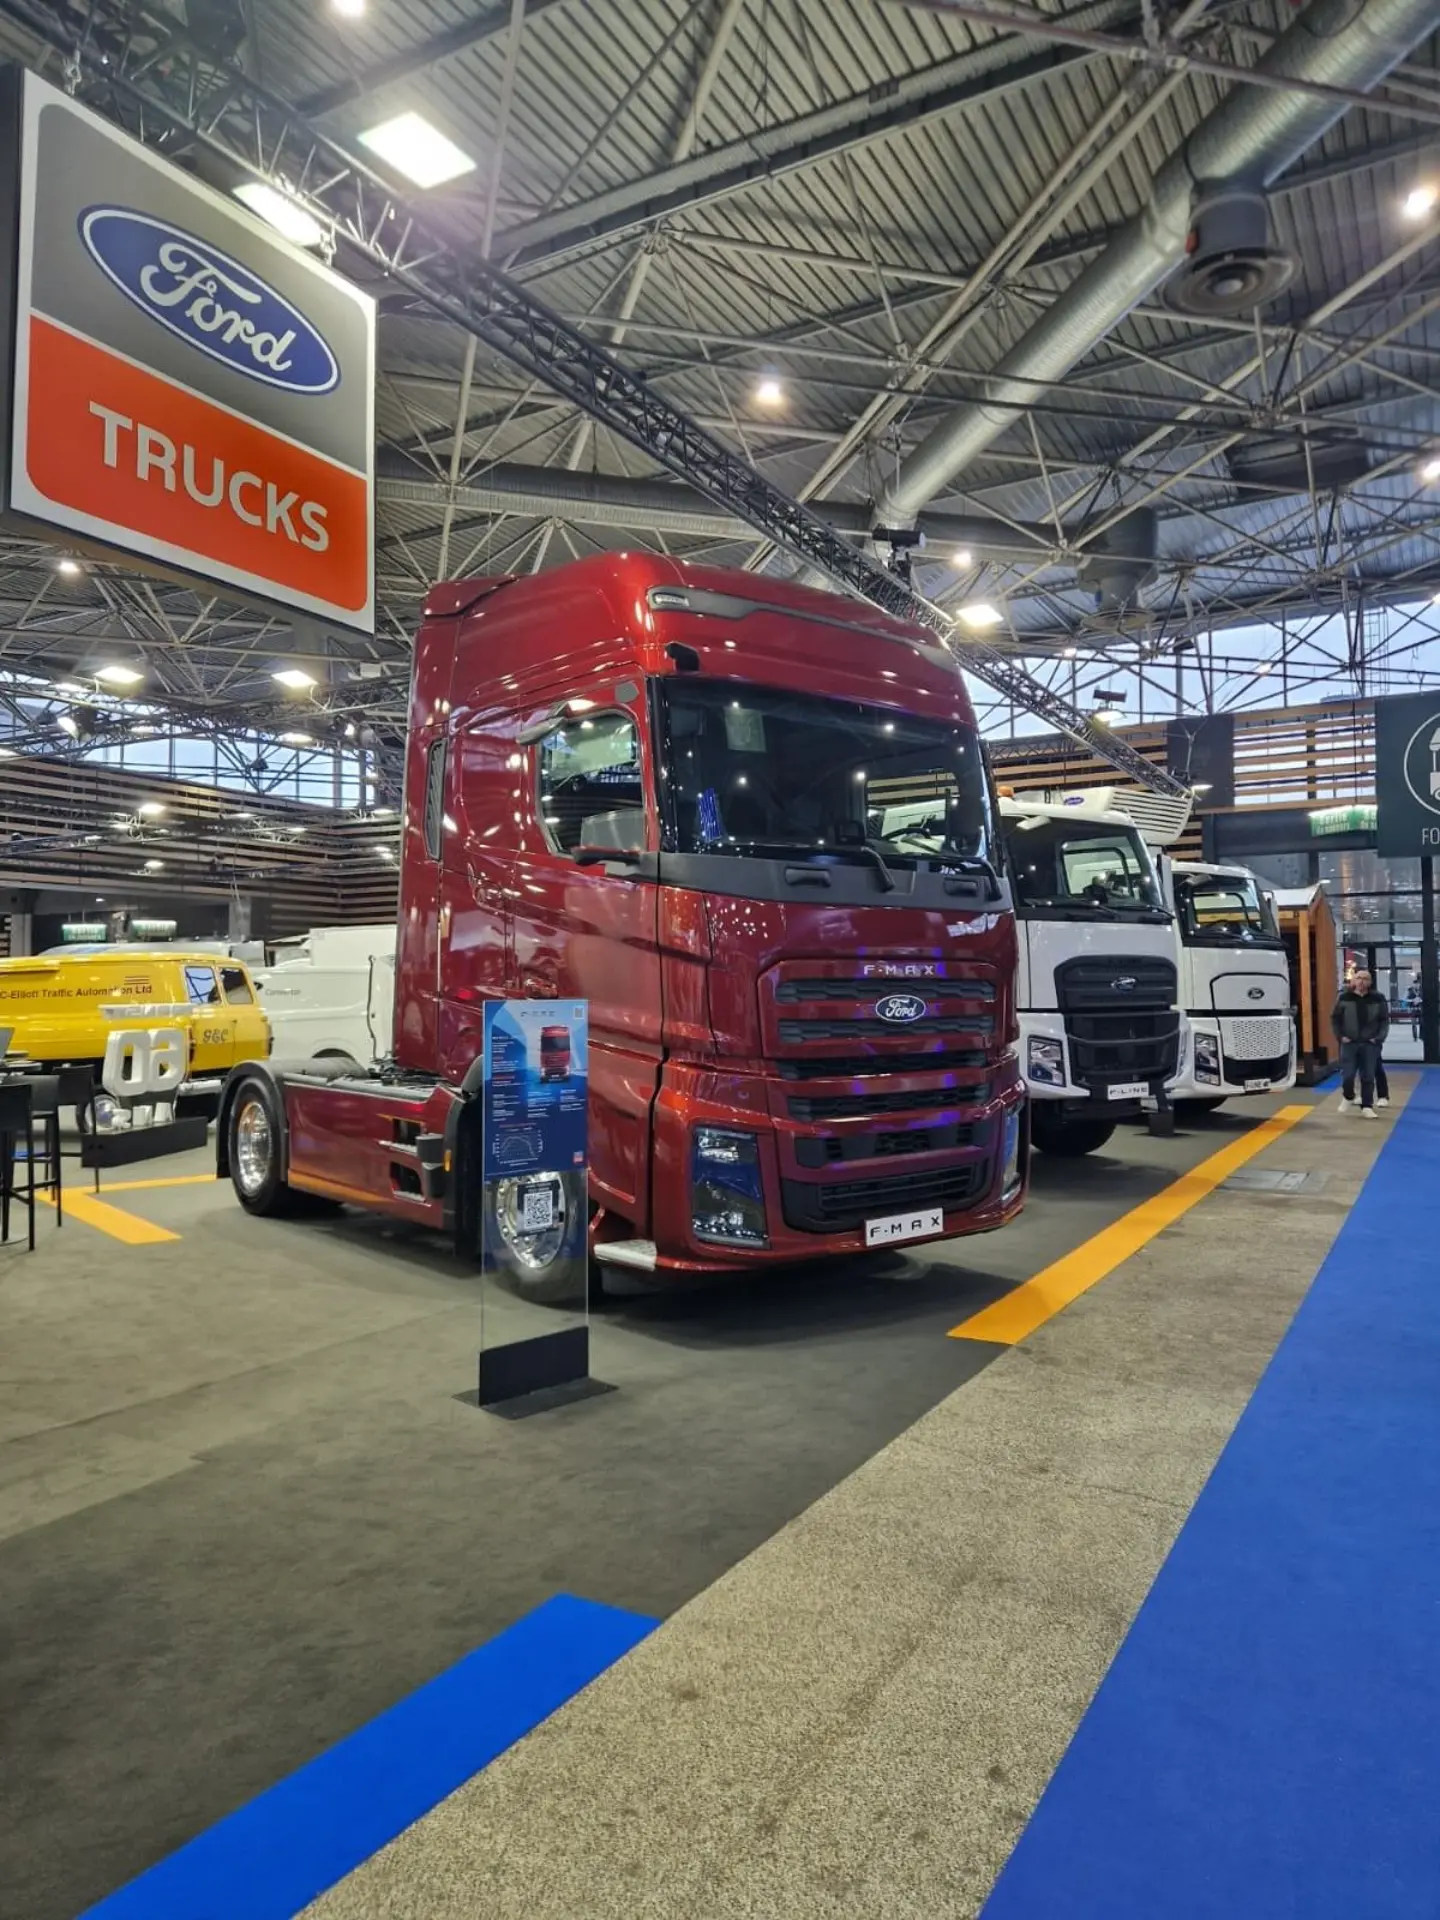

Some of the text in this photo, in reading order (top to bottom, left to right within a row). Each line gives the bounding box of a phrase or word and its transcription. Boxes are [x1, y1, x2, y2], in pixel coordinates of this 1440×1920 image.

[140, 240, 297, 374] Ford
[89, 400, 330, 552] TRUCKS
[42, 988, 73, 998] Traffic
[135, 985, 152, 994] Ltd
[885, 998, 917, 1017] Ford
